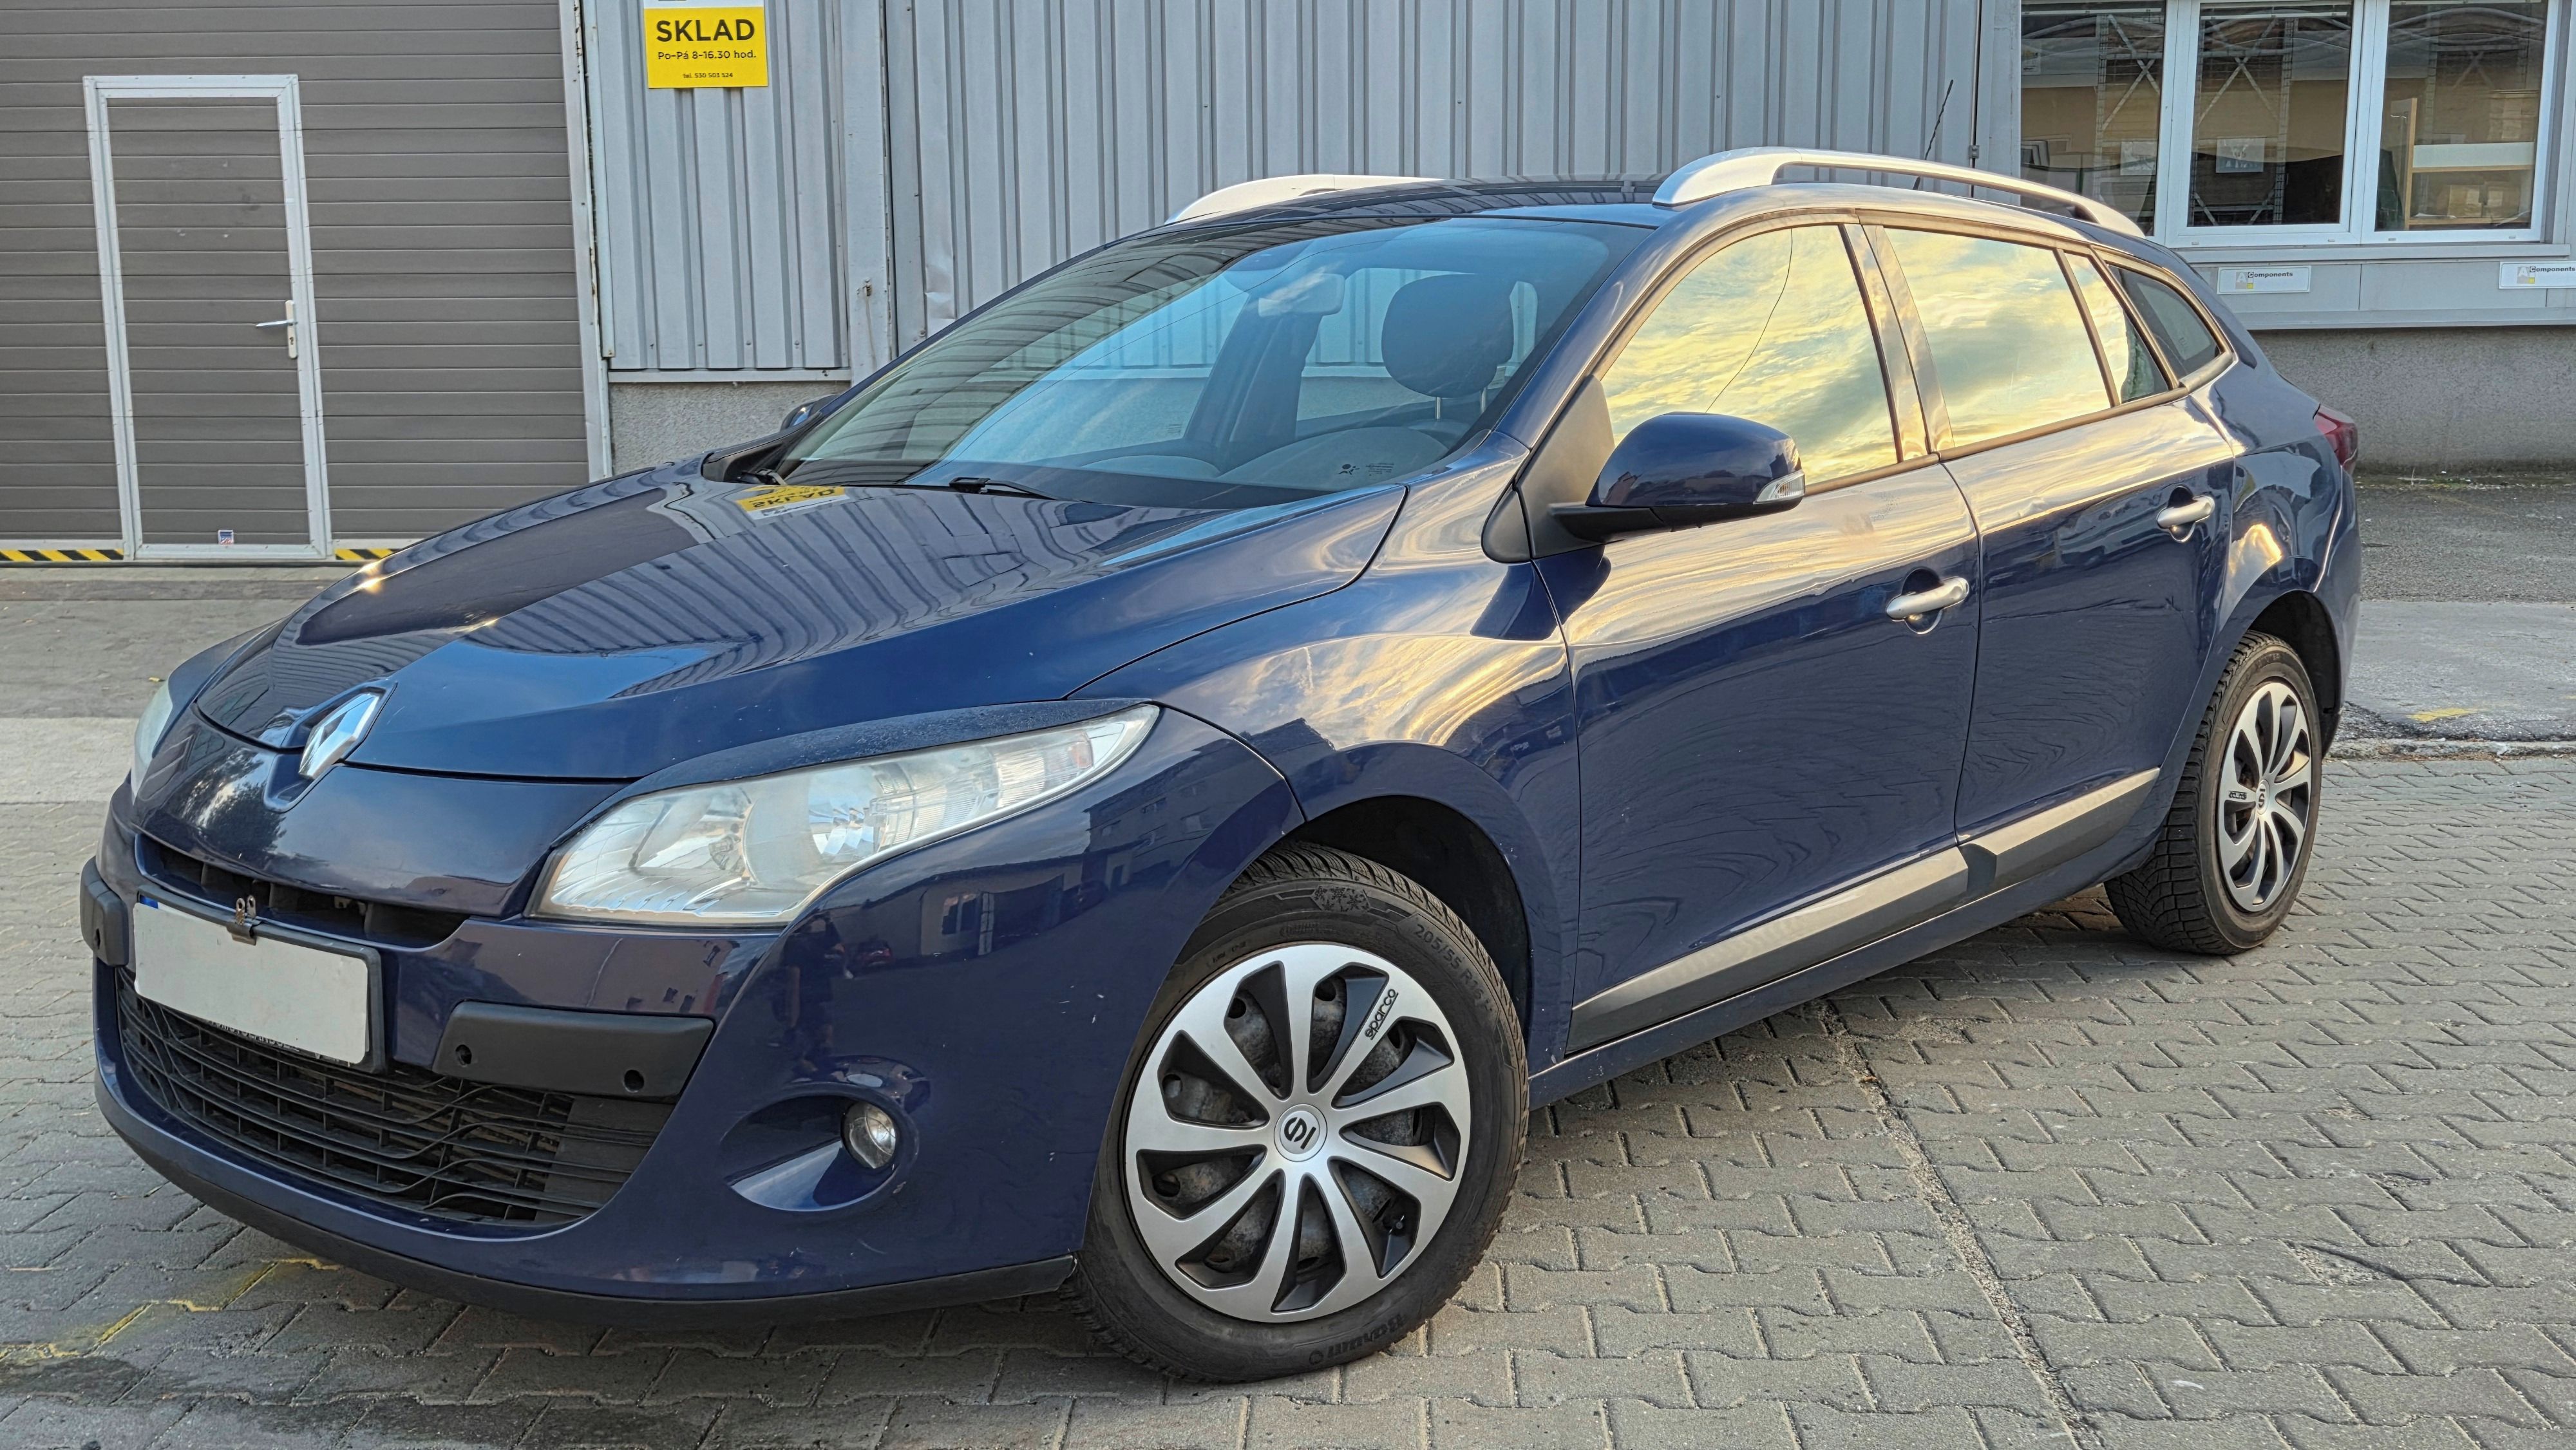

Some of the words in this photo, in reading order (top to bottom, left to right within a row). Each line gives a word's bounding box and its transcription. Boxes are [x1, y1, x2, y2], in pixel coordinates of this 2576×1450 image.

[656, 19, 755, 42] SKLAD
[658, 50, 689, 60] Po-Pá
[692, 50, 731, 59] 8-16.30
[734, 50, 757, 59] hod.
[1414, 923, 1463, 970] 205/55
[1365, 988, 1399, 1040] sparco
